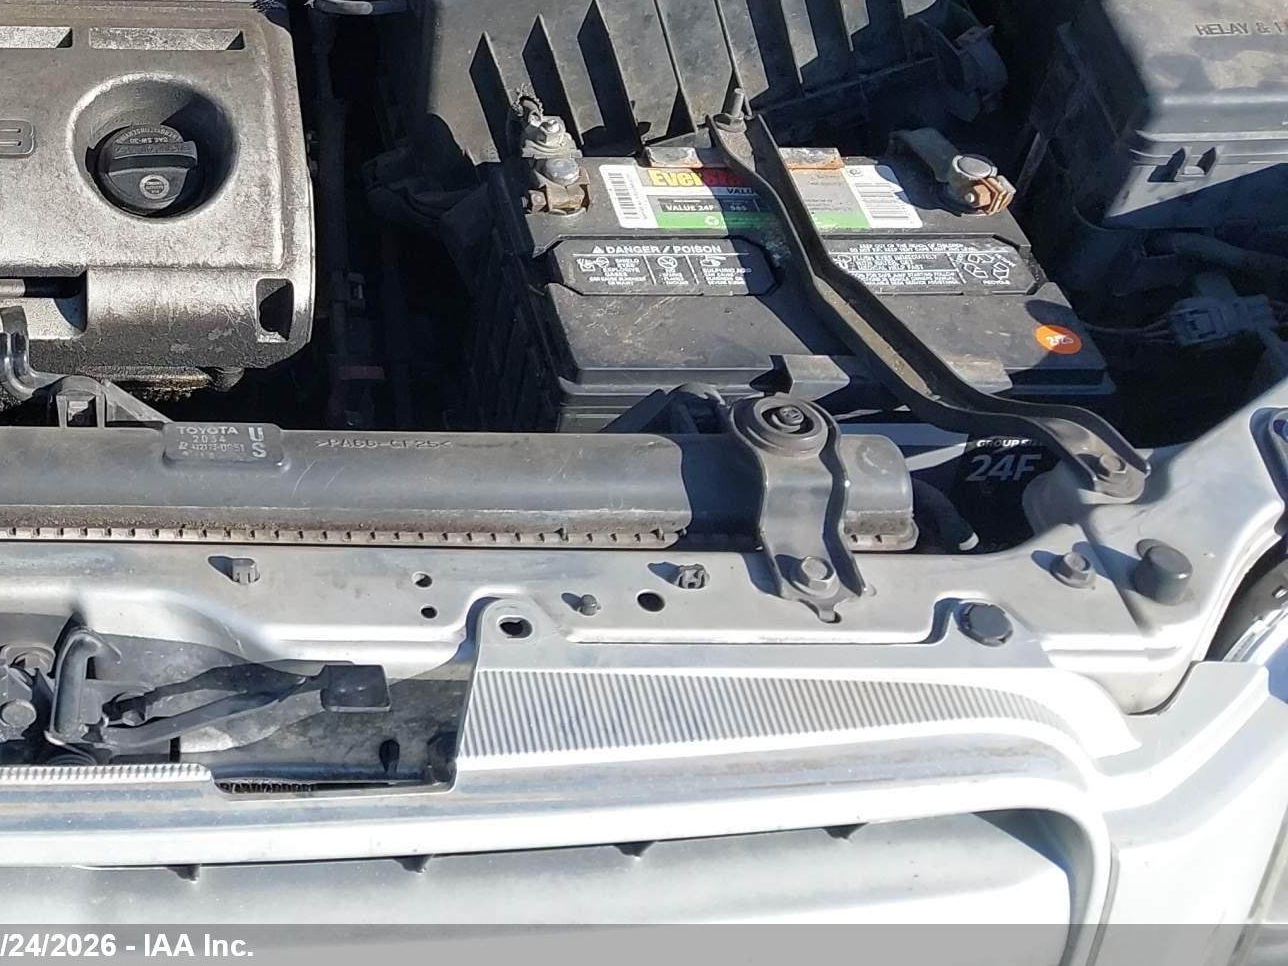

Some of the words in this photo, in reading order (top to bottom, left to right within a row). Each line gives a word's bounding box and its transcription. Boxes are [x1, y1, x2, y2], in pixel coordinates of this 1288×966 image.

[1195, 23, 1249, 35] RELAY
[1256, 23, 1270, 34] &
[666, 203, 696, 211] VALUE
[605, 245, 662, 254] DANGER
[672, 245, 722, 254] POISON
[176, 426, 239, 435] TOYOTA
[976, 439, 1020, 448] GROUP
[966, 454, 1042, 482] 24F
